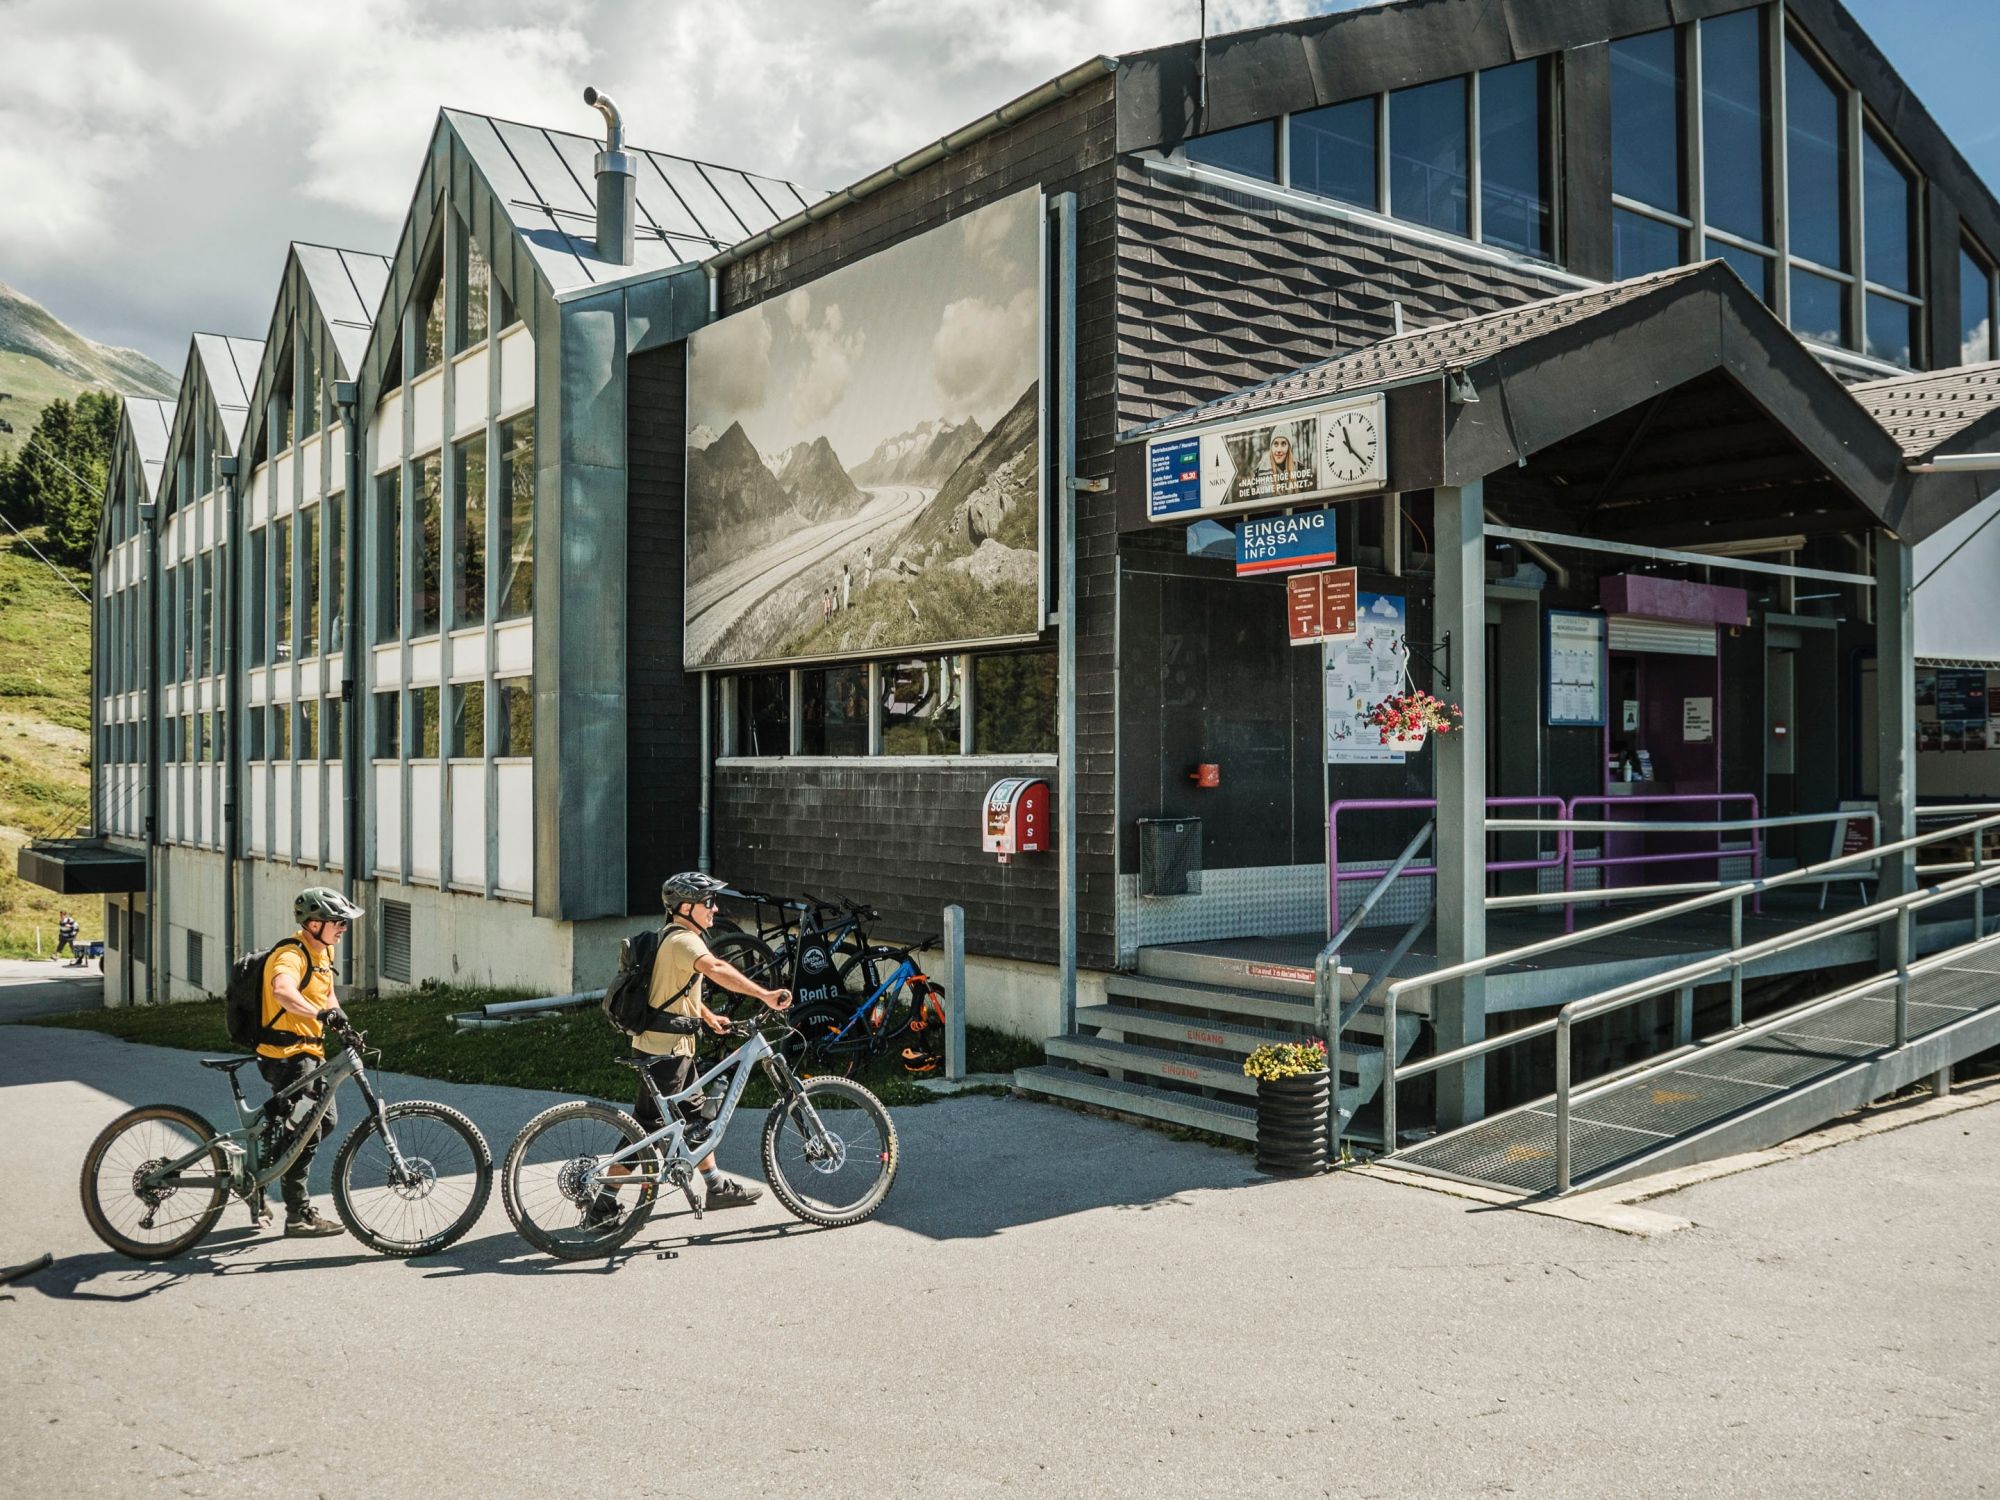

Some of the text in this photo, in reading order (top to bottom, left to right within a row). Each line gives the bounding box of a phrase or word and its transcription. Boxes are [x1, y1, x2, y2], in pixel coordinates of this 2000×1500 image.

[1291, 468, 1313, 480] MODE,
[1239, 488, 1250, 497] DIE
[1244, 514, 1325, 538] EINGANG
[1244, 533, 1299, 548] KASSA
[1244, 546, 1277, 560] INFO
[990, 802, 1008, 812] SOS
[800, 984, 839, 1002] Rent a
[1187, 1030, 1224, 1045] EINGANG
[1162, 1063, 1198, 1079] EINGANG
[732, 1065, 749, 1098] CRUZ
